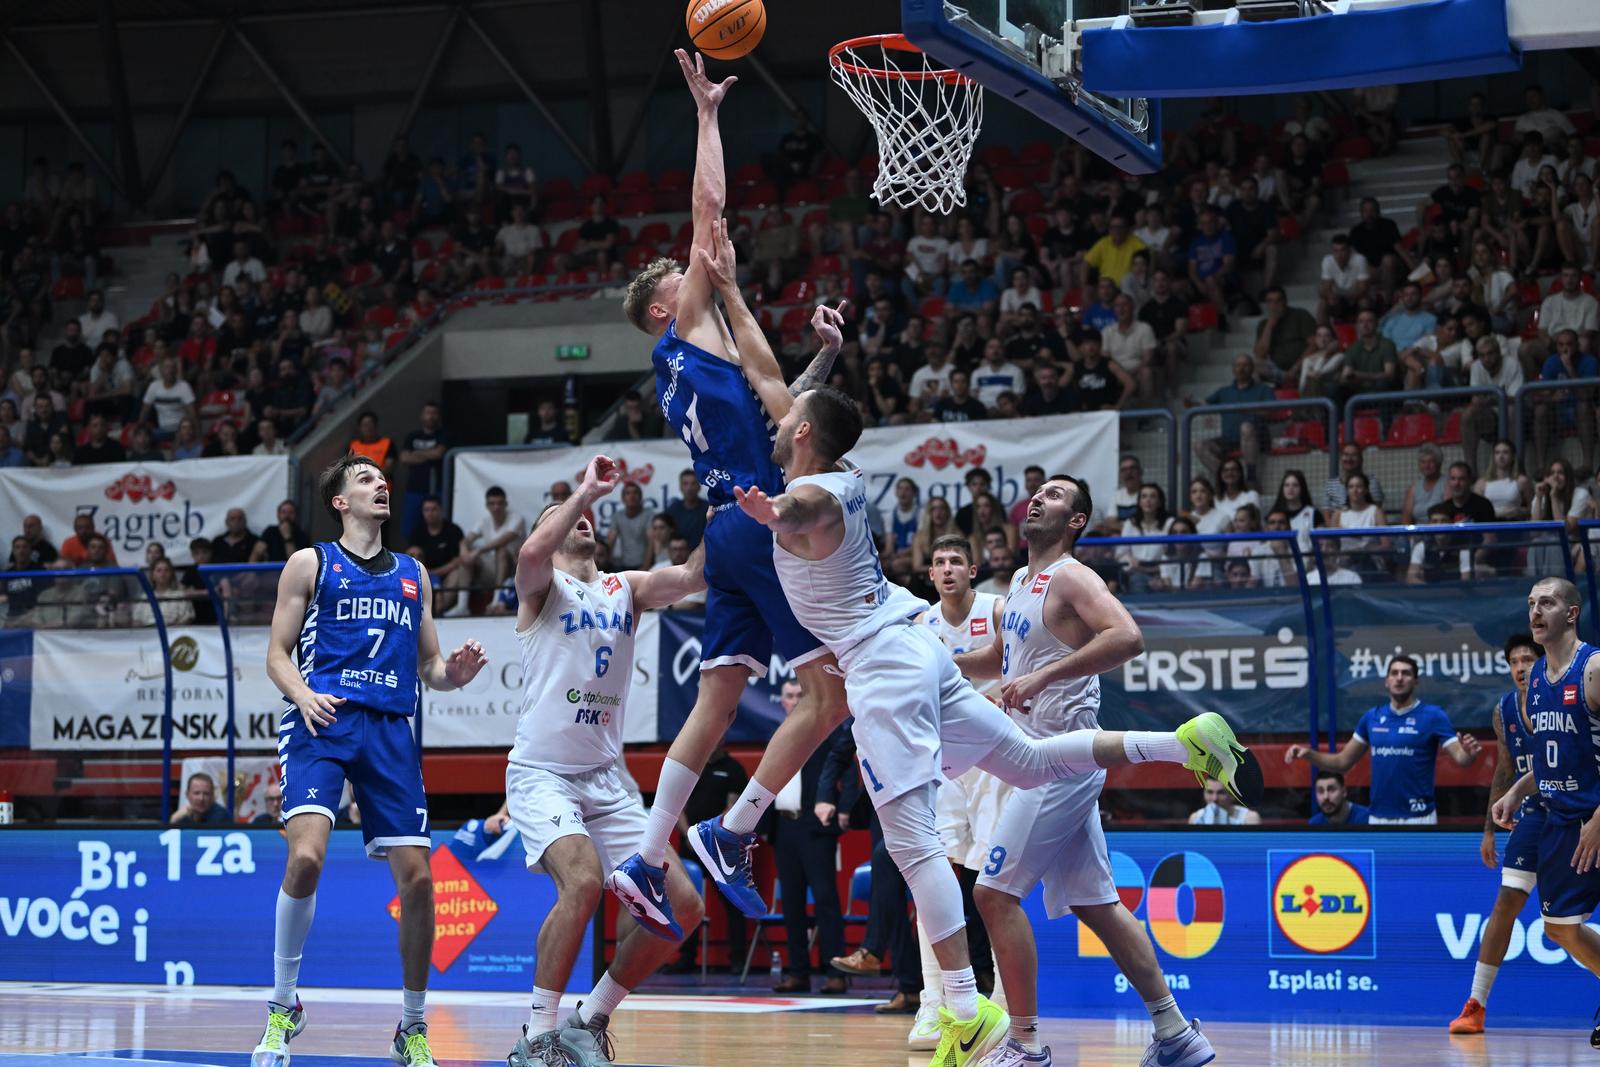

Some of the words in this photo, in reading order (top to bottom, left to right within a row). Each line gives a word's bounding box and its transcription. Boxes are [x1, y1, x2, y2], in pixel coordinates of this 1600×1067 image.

[336, 597, 413, 631] CIBONA
[559, 608, 633, 636] ZADAR
[367, 628, 386, 659] 7
[595, 646, 613, 678] 6
[1123, 648, 1257, 692] ERSTE
[340, 678, 361, 688] Bank
[341, 668, 384, 685] ERSTE
[428, 701, 480, 716] Events
[486, 701, 496, 716] &
[1531, 711, 1578, 734] CIBONA
[53, 713, 240, 741] MAGAZINSKA
[1546, 740, 1558, 768] 0
[862, 758, 884, 792] 1
[1539, 779, 1566, 792] ERSTE
[416, 807, 428, 833] 7
[78, 840, 147, 891] Br.
[159, 828, 182, 881] 1
[195, 832, 256, 876] za
[984, 845, 1007, 877] 9
[432, 879, 469, 894] ema
[0, 886, 120, 945] voće
[132, 908, 149, 962] i
[434, 921, 476, 942] paca
[1268, 969, 1342, 994] Isplati
[1347, 975, 1379, 991] se.
